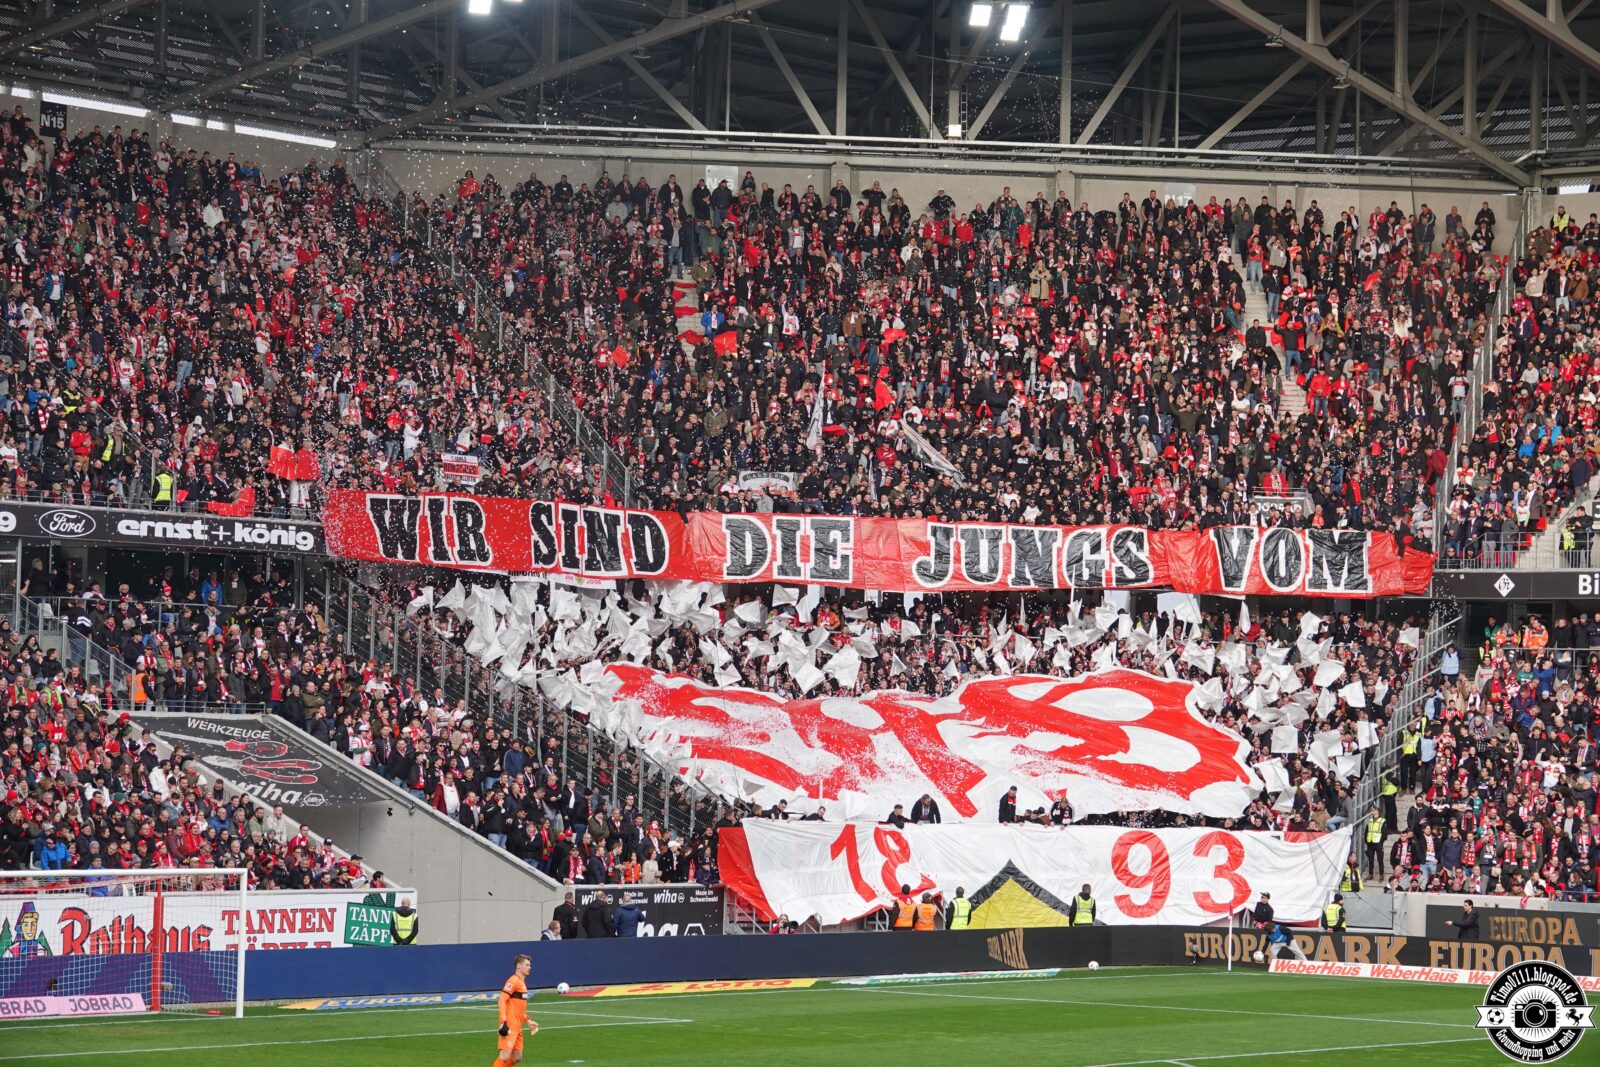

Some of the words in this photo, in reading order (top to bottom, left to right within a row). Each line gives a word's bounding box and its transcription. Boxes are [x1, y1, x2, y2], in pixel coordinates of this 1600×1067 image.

[40, 113, 65, 130] N15
[50, 511, 85, 535] Ford
[365, 493, 493, 567] WIR
[528, 501, 669, 577] SIND
[721, 513, 855, 583] DIE
[911, 521, 1154, 591] JUNGS
[1209, 524, 1373, 594] VOM
[187, 717, 271, 740] WERKZEUGE
[653, 889, 677, 904] wiha
[221, 908, 337, 935] TANNEN
[350, 906, 392, 924] TANN
[350, 923, 394, 943] ZÄPF
[1488, 916, 1583, 946] EUROPA
[1183, 932, 1271, 963] EUROP
[1299, 935, 1408, 966] PARK
[1274, 959, 1361, 976] WeberHaus
[1370, 964, 1459, 983] WeberHaus
[685, 979, 793, 990] LOTTO
[68, 996, 134, 1012] JOBRAD
[323, 995, 443, 1007] EUROPA
